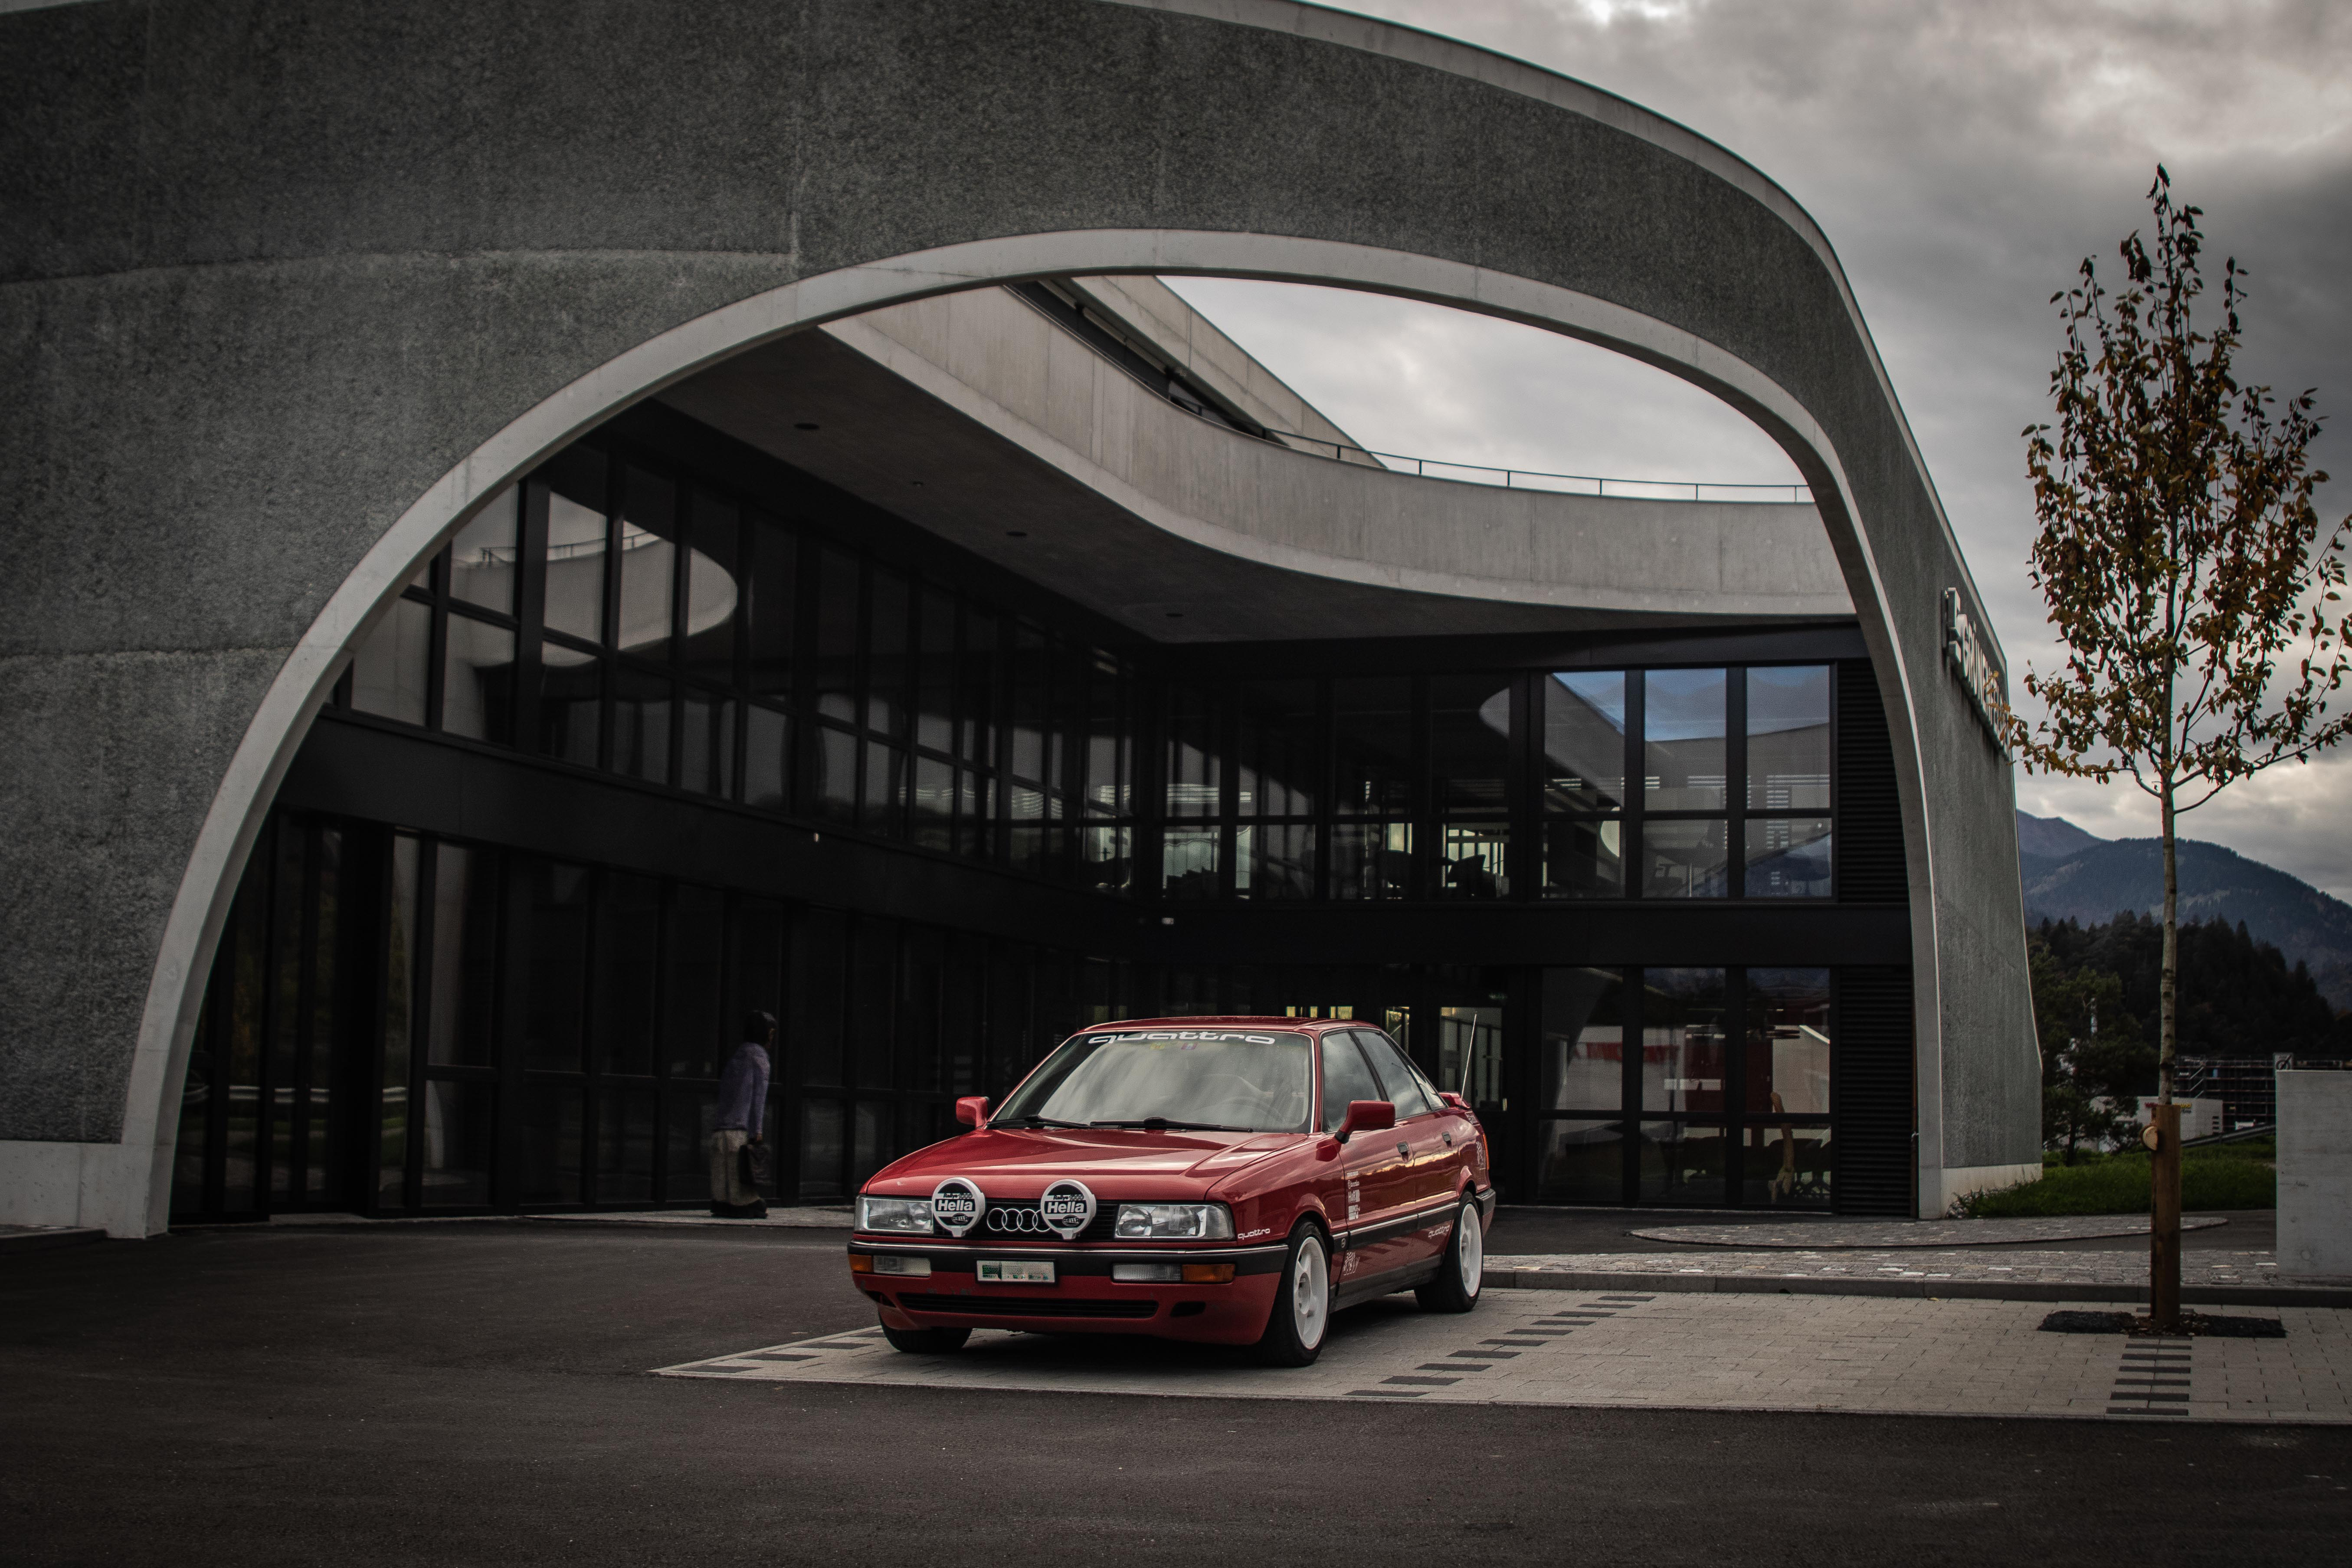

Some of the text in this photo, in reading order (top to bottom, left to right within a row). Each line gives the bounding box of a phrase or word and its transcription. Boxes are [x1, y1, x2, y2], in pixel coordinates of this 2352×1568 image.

[1088, 1031, 1274, 1044] quattro
[938, 1200, 973, 1211] Hella
[1047, 1201, 1084, 1213] Hella
[1238, 1228, 1270, 1240] quattro
[1428, 1225, 1450, 1239] quattro
